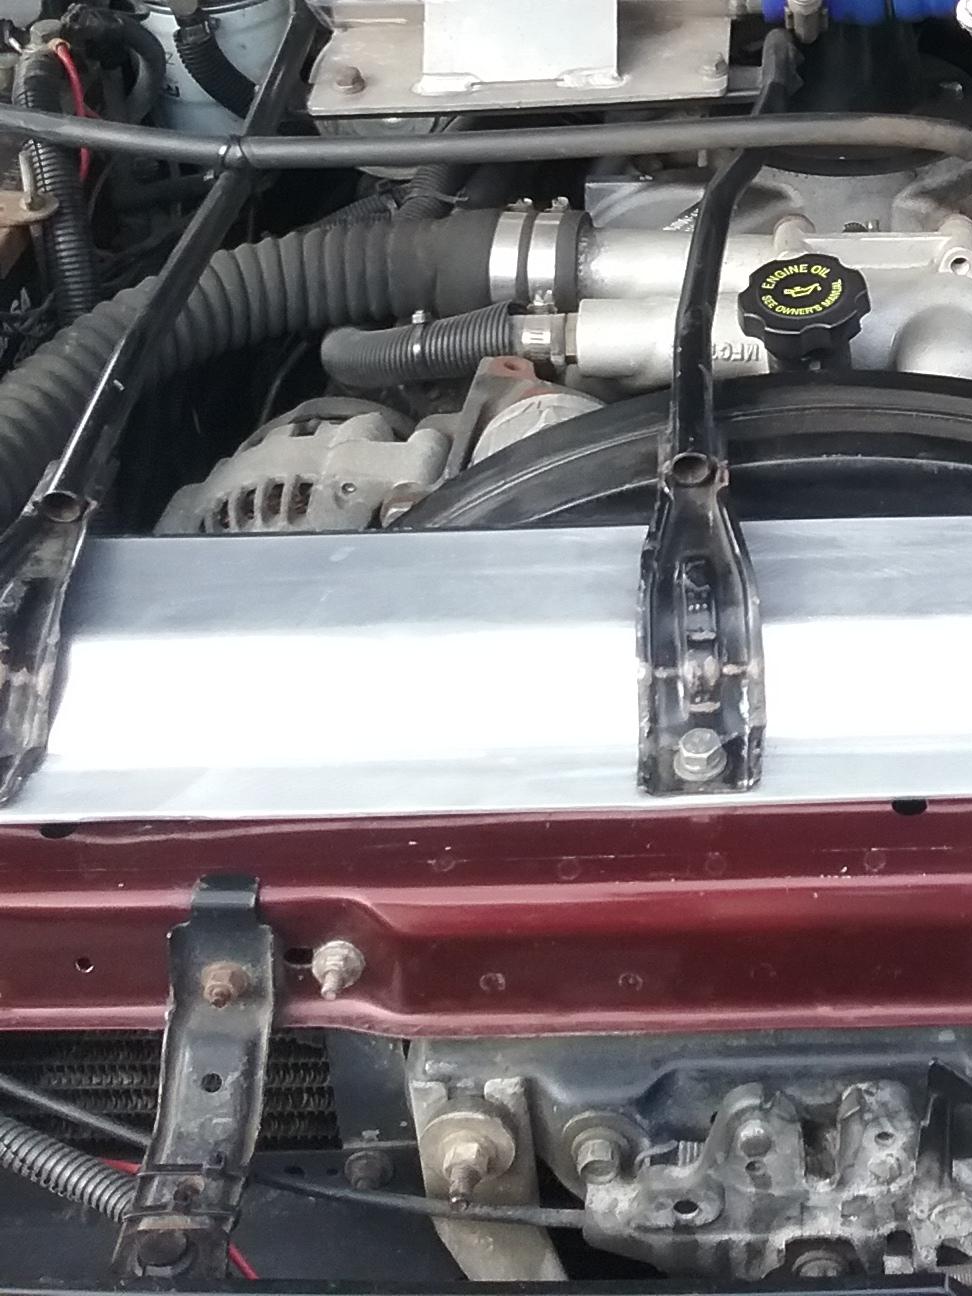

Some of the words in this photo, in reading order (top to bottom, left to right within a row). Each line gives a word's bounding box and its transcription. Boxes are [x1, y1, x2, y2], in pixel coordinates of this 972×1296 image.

[762, 263, 809, 290] ENGINE
[810, 264, 831, 279] OIL
[761, 294, 774, 309] SEE
[775, 302, 823, 316] OWNER'S
